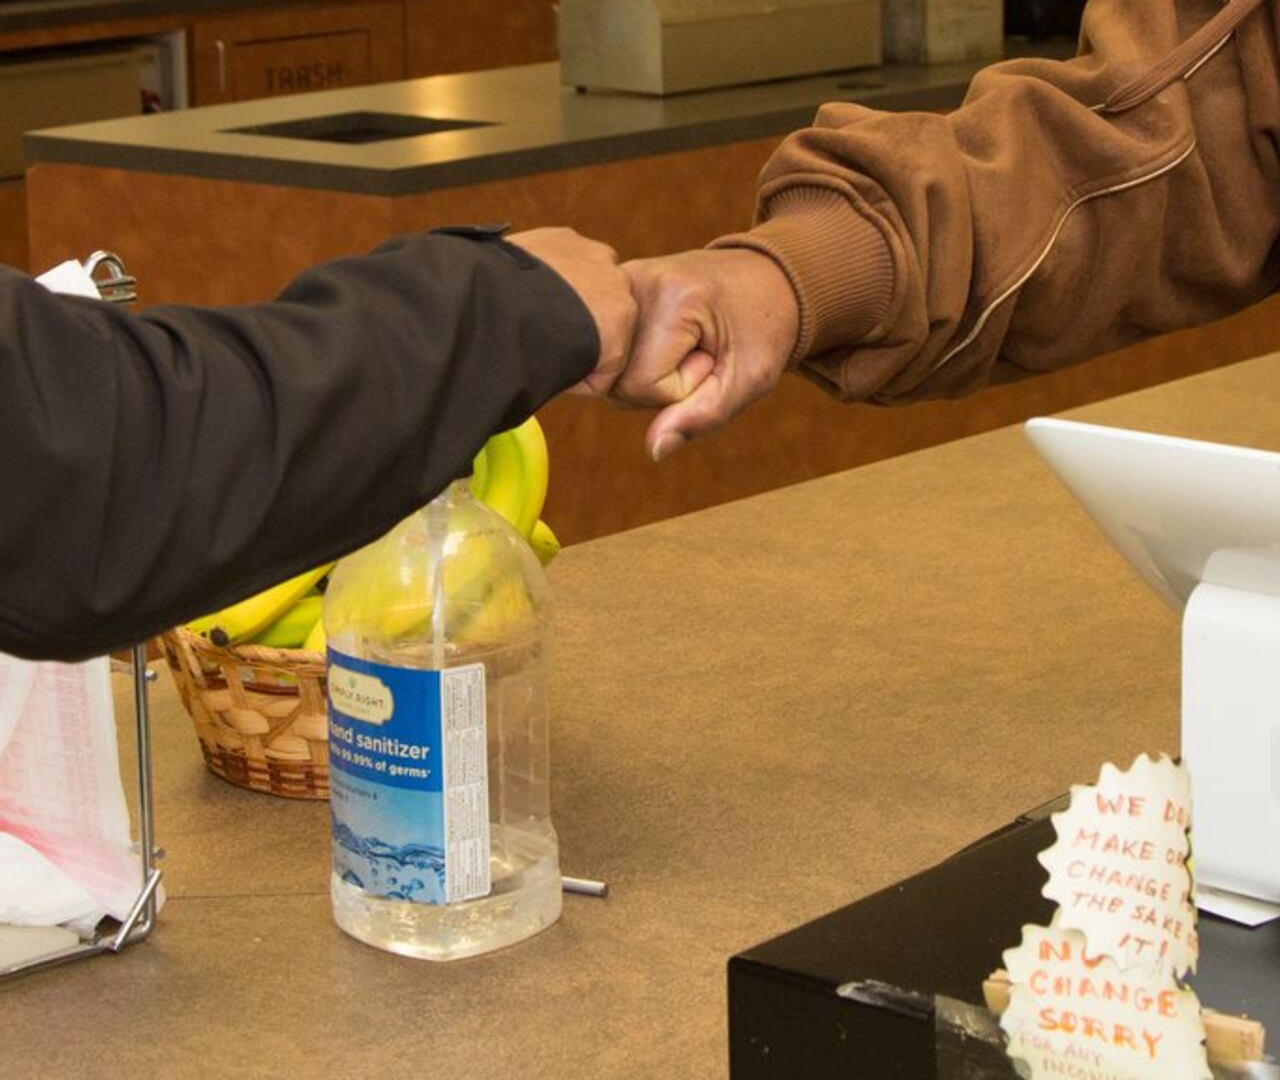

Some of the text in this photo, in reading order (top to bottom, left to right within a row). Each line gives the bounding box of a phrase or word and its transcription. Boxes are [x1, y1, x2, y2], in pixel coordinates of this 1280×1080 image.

[357, 733, 430, 761] sanitizer
[1096, 793, 1146, 818] WE
[1075, 828, 1155, 862] MAKE
[1066, 860, 1172, 902] CHANGE
[1073, 891, 1183, 941] THE SAKE
[1029, 970, 1179, 1019] CHANGE
[1038, 1008, 1164, 1060] SORRY
